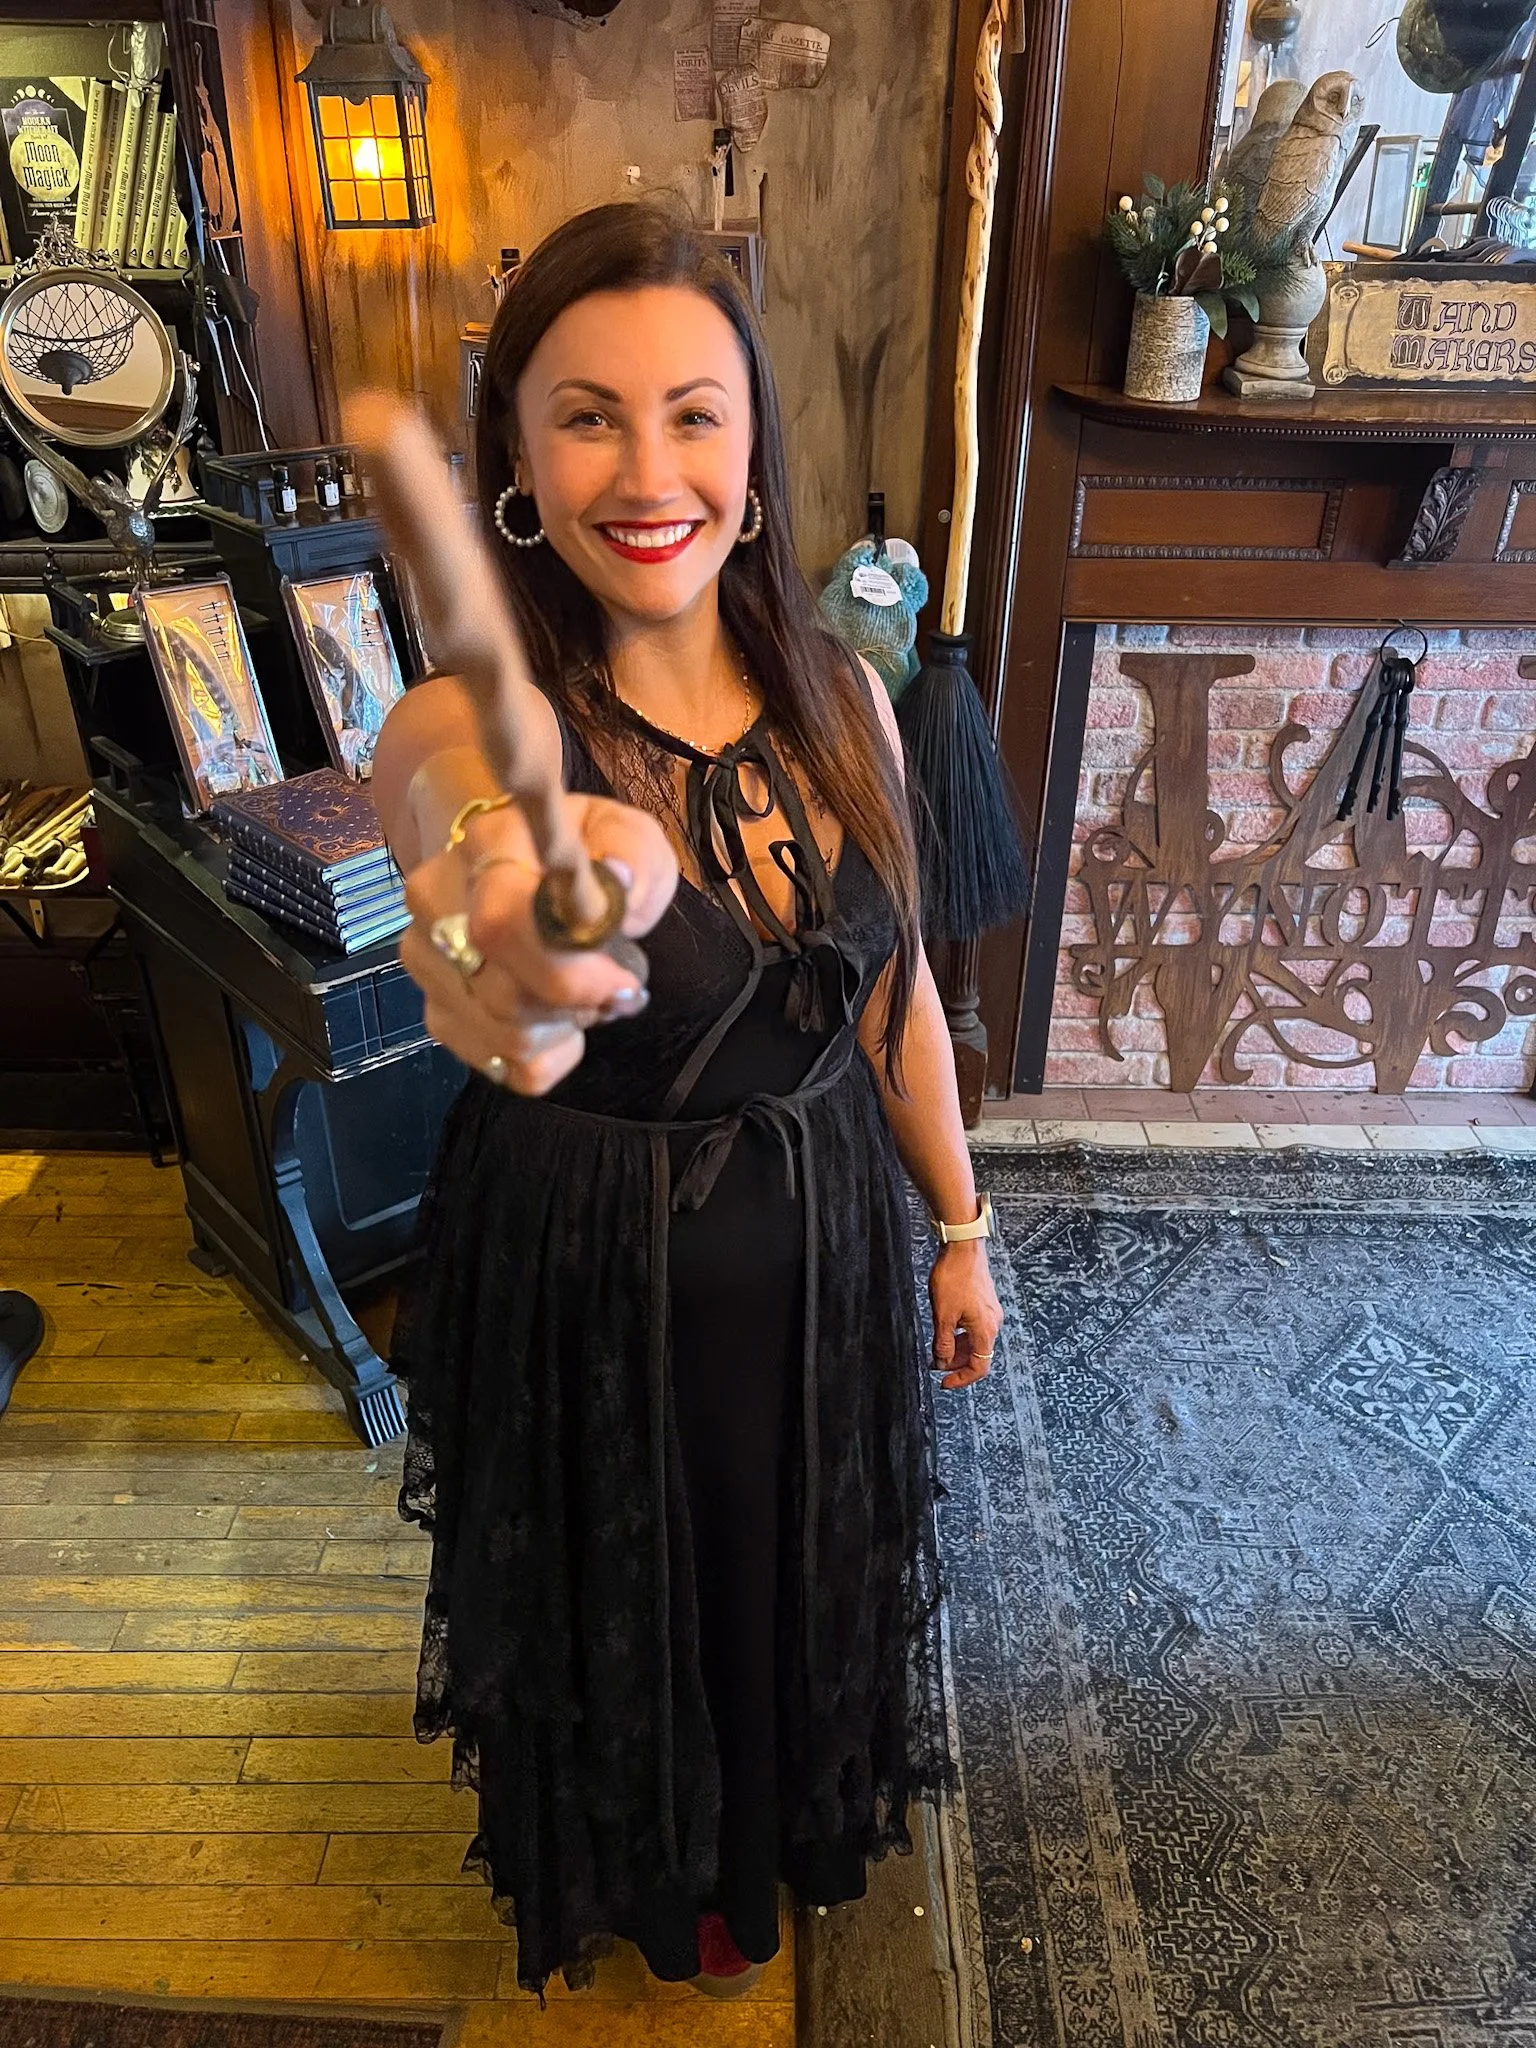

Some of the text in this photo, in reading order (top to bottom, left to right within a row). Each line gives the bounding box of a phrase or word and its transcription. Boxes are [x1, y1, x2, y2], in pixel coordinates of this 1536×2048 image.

[22, 116, 51, 125] MODERN
[24, 142, 60, 163] Moon
[23, 166, 71, 190] Magick
[83, 171, 93, 190] Moon
[119, 171, 129, 191] Moon
[156, 171, 165, 191] Moon
[81, 191, 91, 217] Magick
[101, 191, 110, 217] Magick
[117, 191, 127, 217] Magick
[134, 192, 145, 217] Magick
[152, 192, 162, 218] Magick
[1397, 292, 1517, 334] WAND
[1391, 334, 1536, 375] MAKERS
